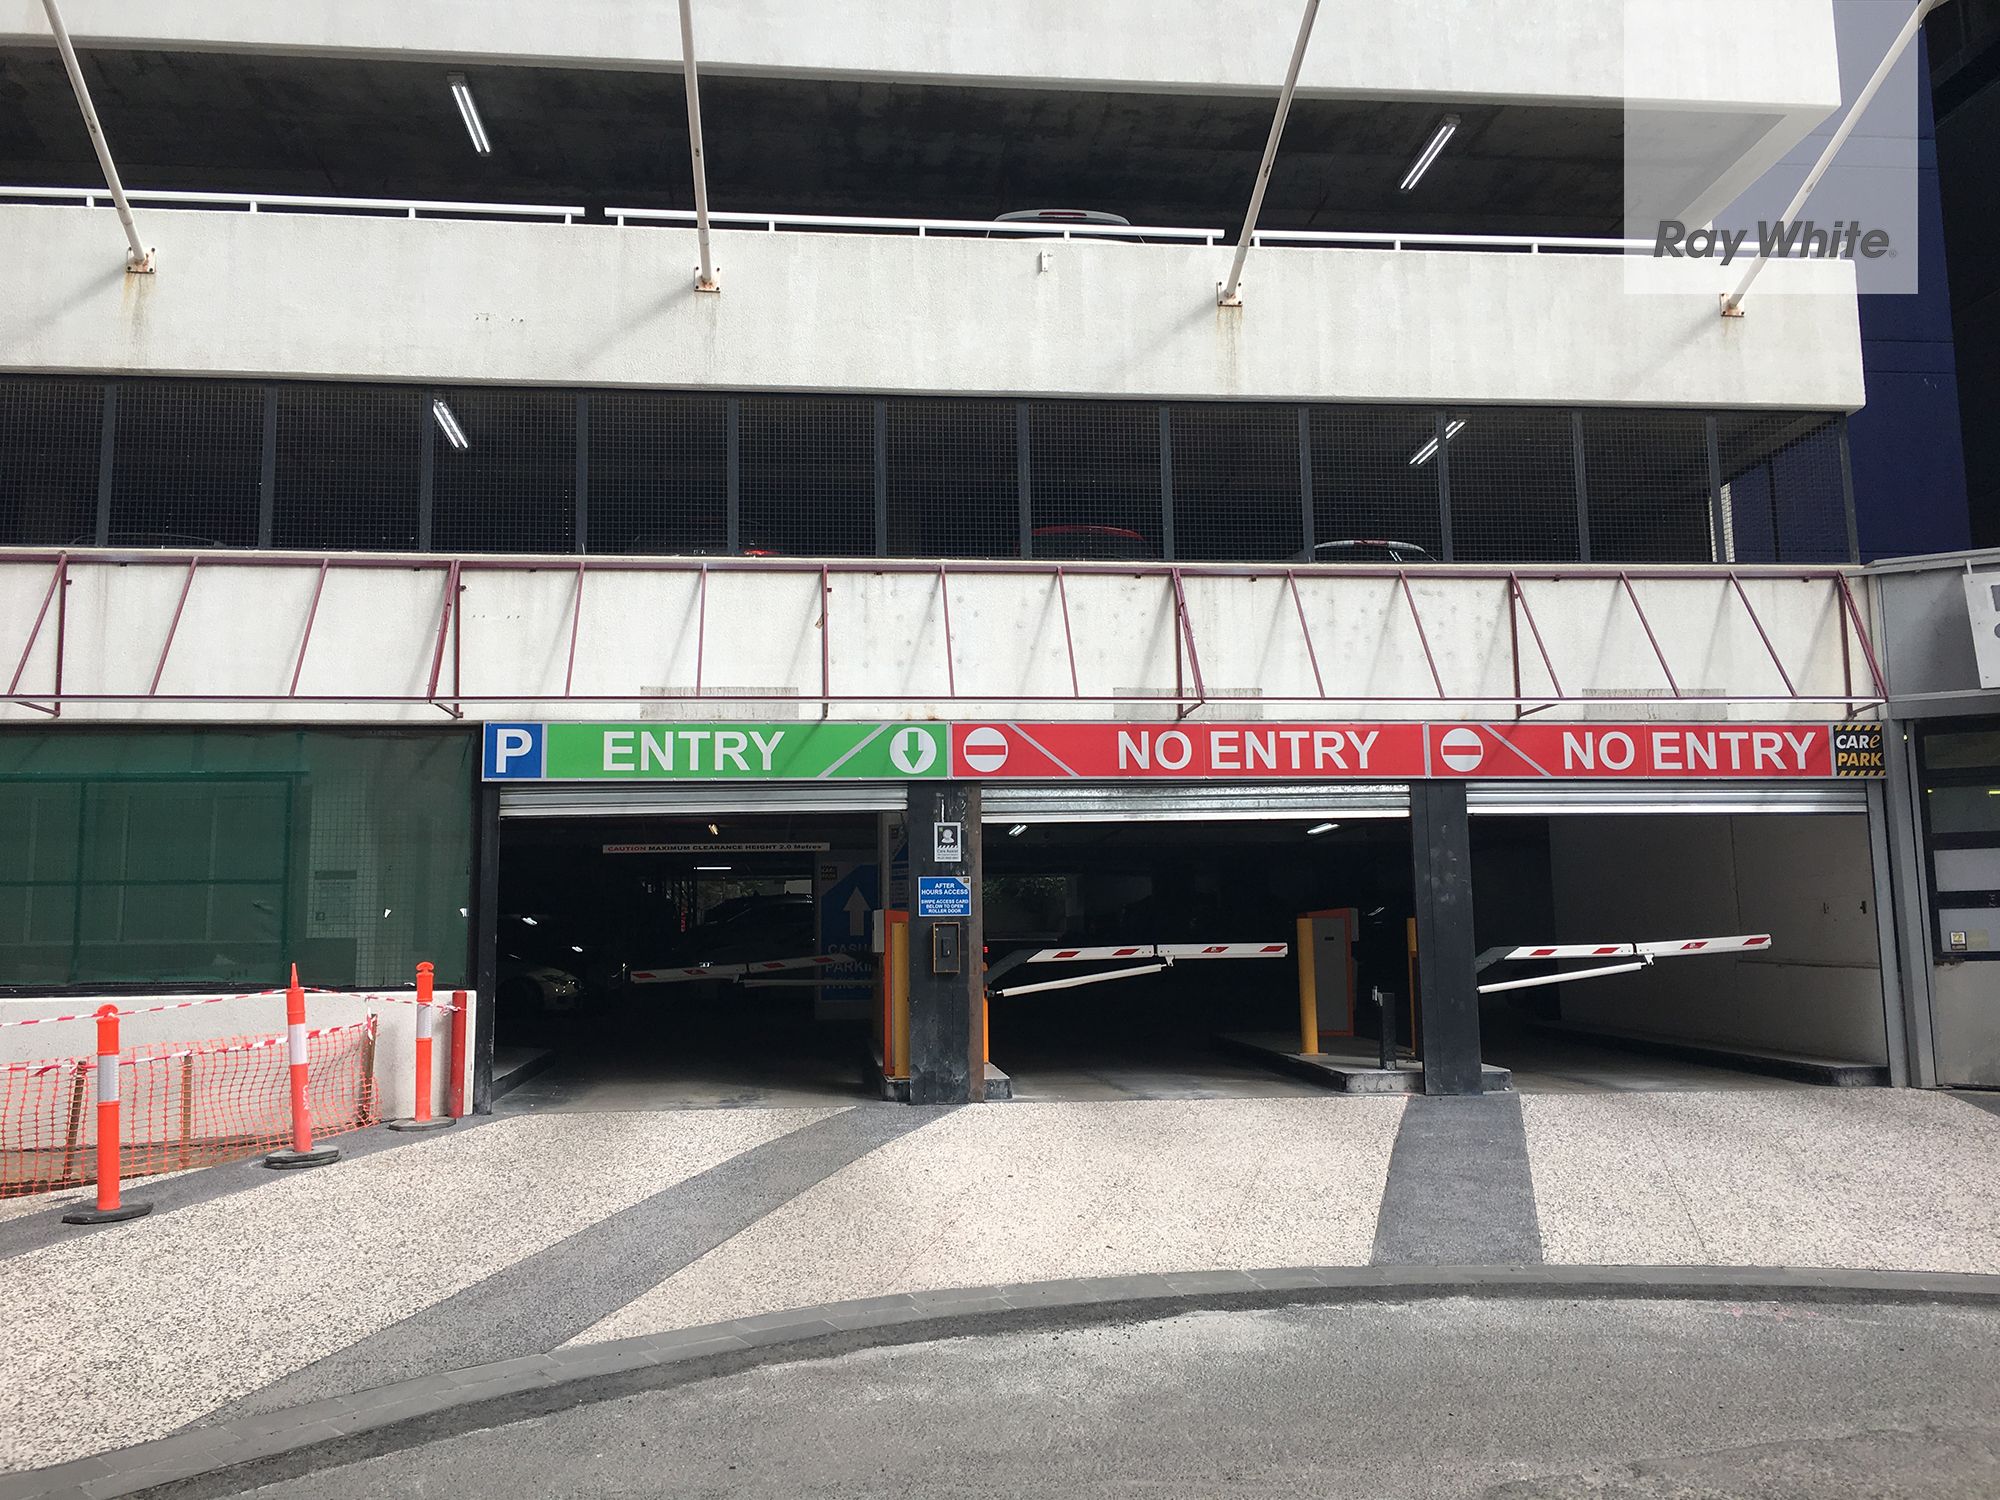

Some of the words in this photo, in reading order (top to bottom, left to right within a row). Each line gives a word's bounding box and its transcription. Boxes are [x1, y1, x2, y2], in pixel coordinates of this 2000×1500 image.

[496, 729, 532, 772] P
[604, 732, 784, 770] ENTRY
[1119, 731, 1191, 769] NO
[1211, 731, 1379, 769] ENTRY
[1563, 732, 1634, 769] NO
[1653, 732, 1815, 769] ENTRY
[1837, 752, 1883, 767] PARK
